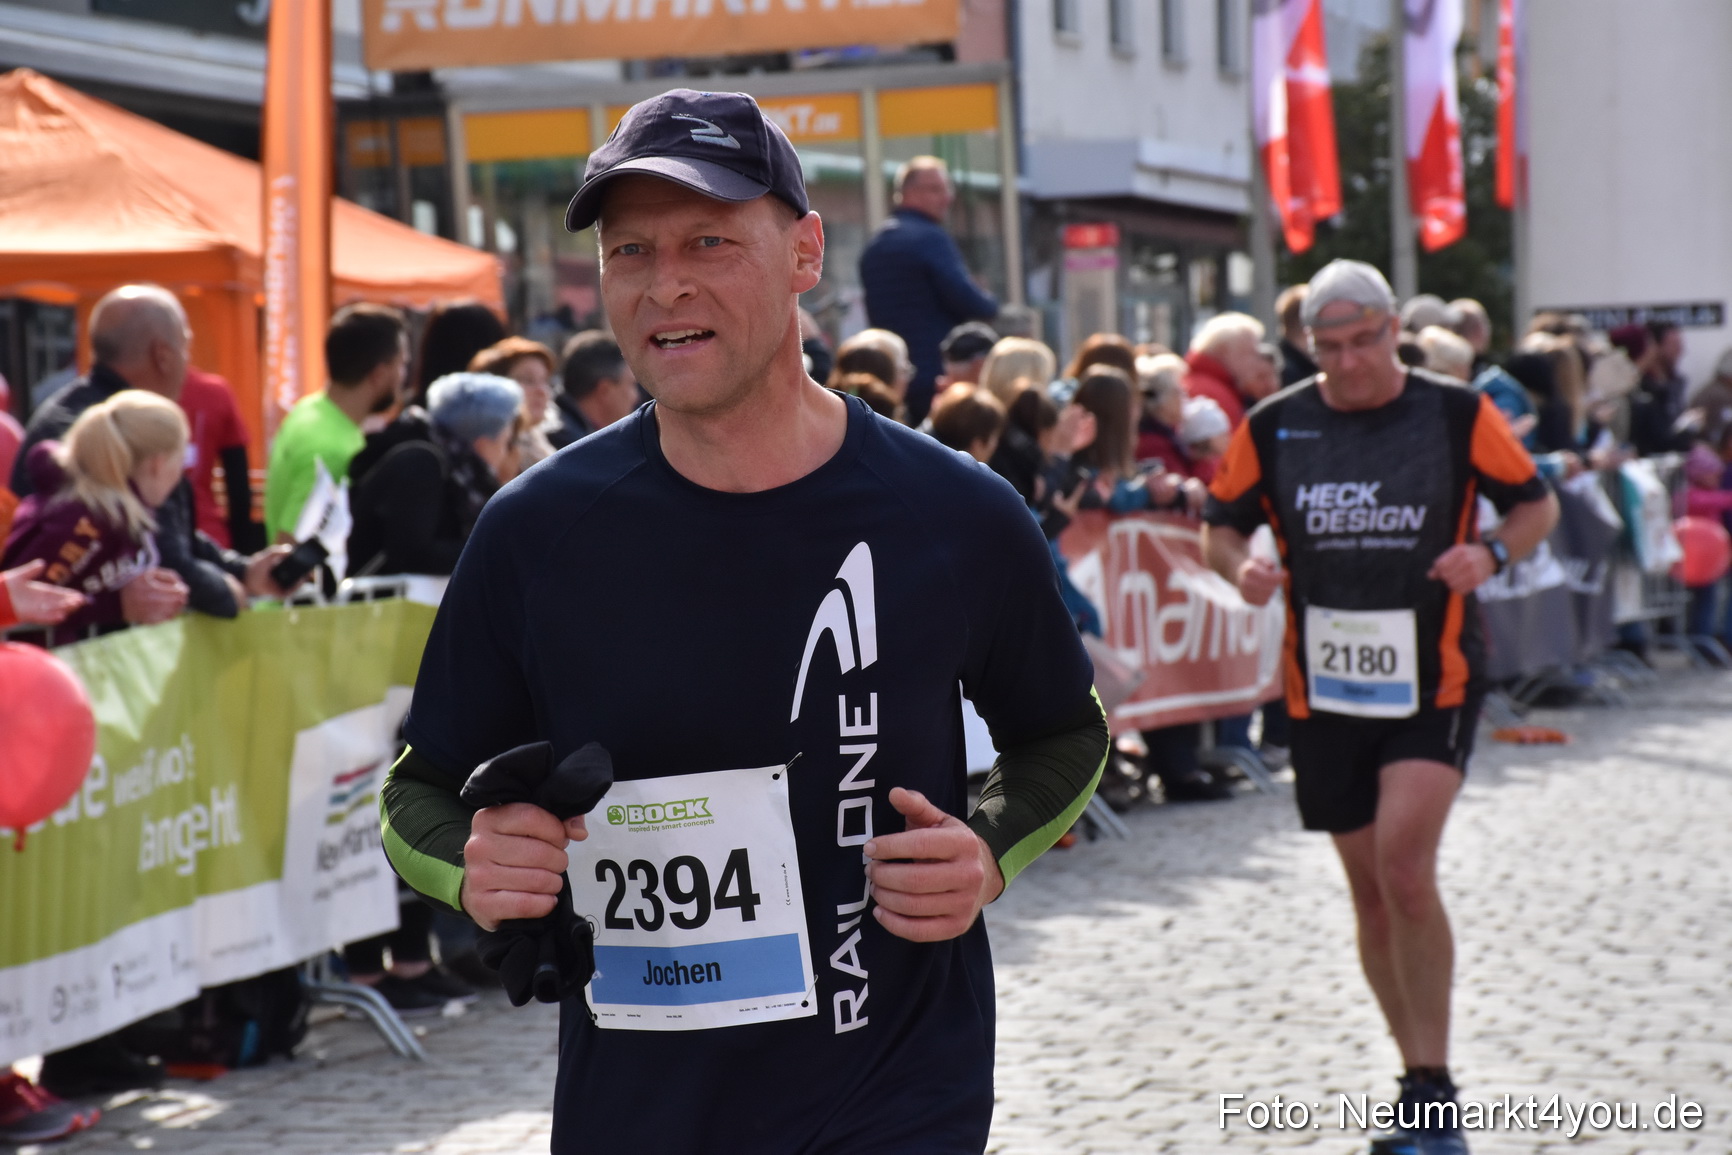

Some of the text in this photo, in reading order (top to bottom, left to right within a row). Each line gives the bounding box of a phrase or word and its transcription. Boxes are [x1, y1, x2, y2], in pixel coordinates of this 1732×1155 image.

[1296, 481, 1381, 511] HECK
[1306, 504, 1426, 534] DESIGN
[1319, 640, 1397, 677] 2180
[626, 797, 713, 824] BOCK
[628, 818, 715, 833] inspired by smart concepts
[595, 848, 760, 931] 2394
[643, 960, 722, 986] Jochen
